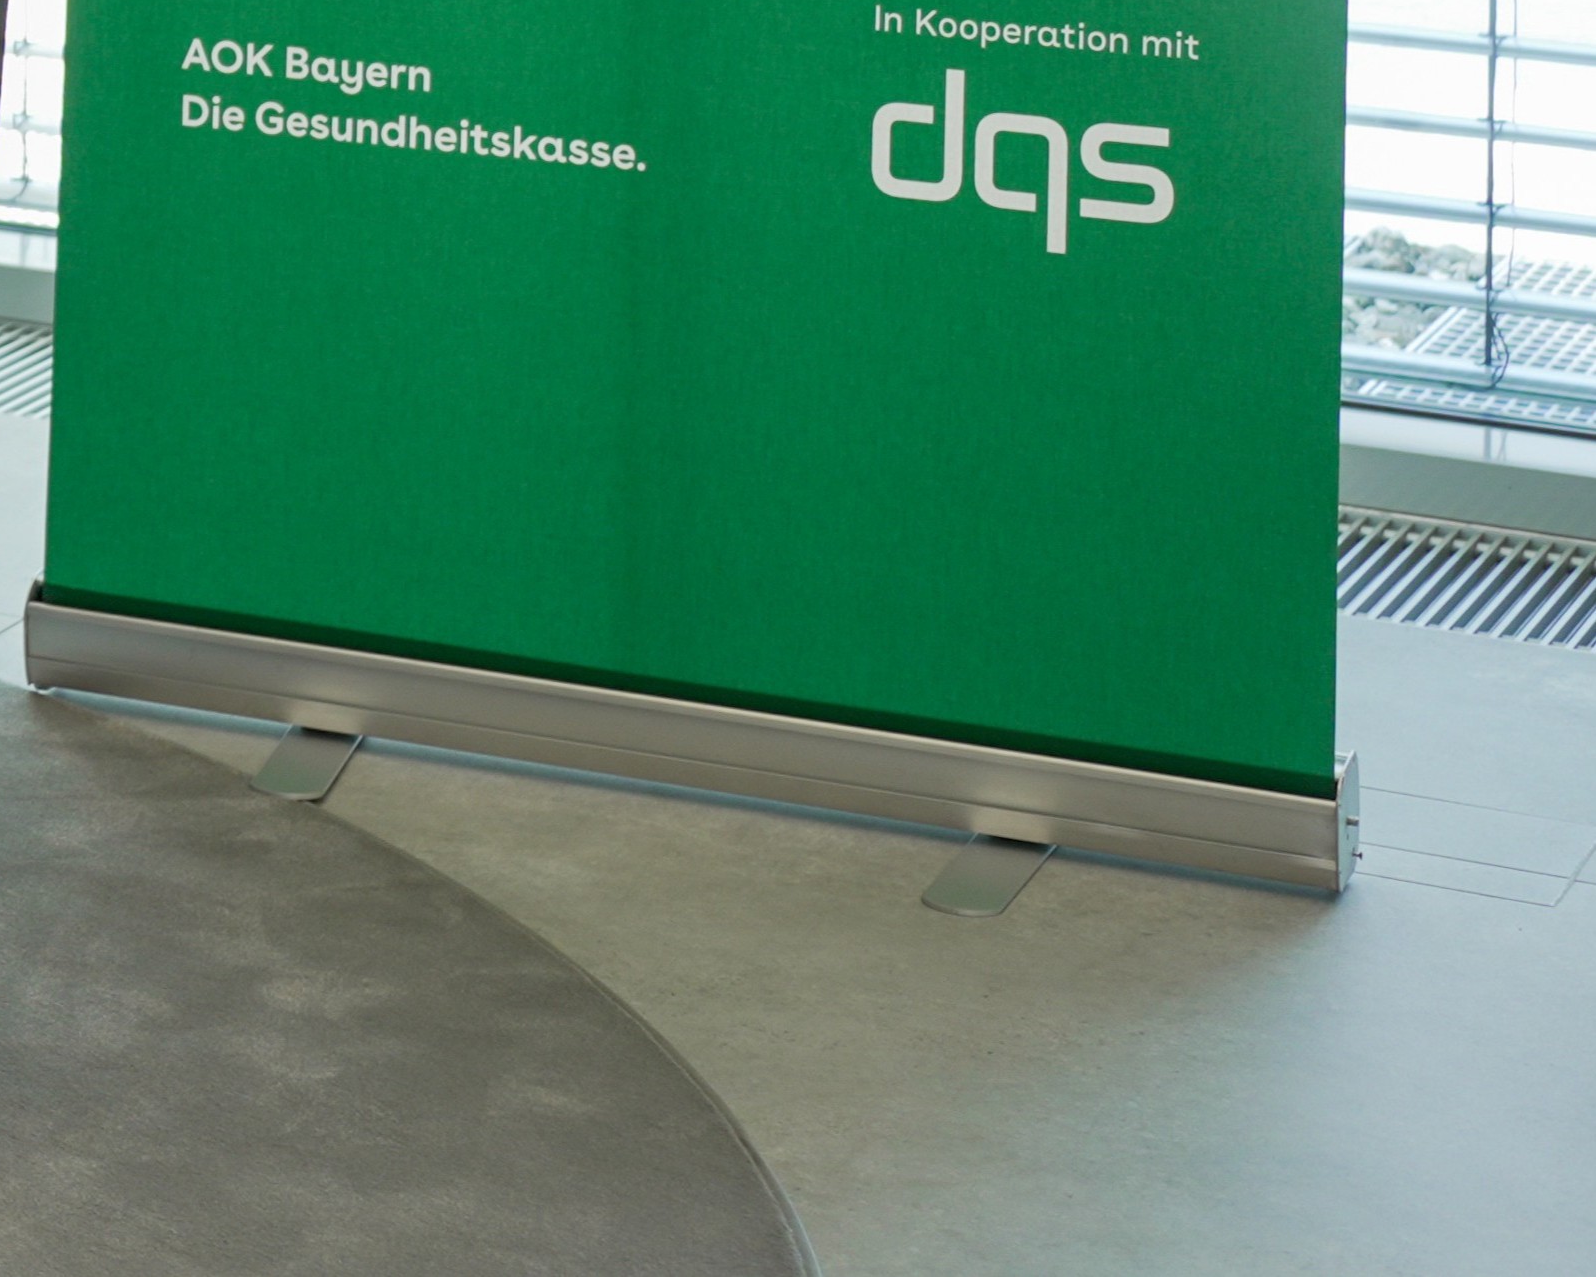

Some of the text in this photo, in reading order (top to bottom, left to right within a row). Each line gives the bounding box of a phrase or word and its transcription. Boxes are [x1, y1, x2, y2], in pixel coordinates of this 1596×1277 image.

[874, 4, 1200, 60] In Kooperation mit
[181, 38, 432, 95] AOK Bayern
[181, 94, 647, 171] Die Gesundheitskasse.
[871, 68, 1175, 255] dqs
